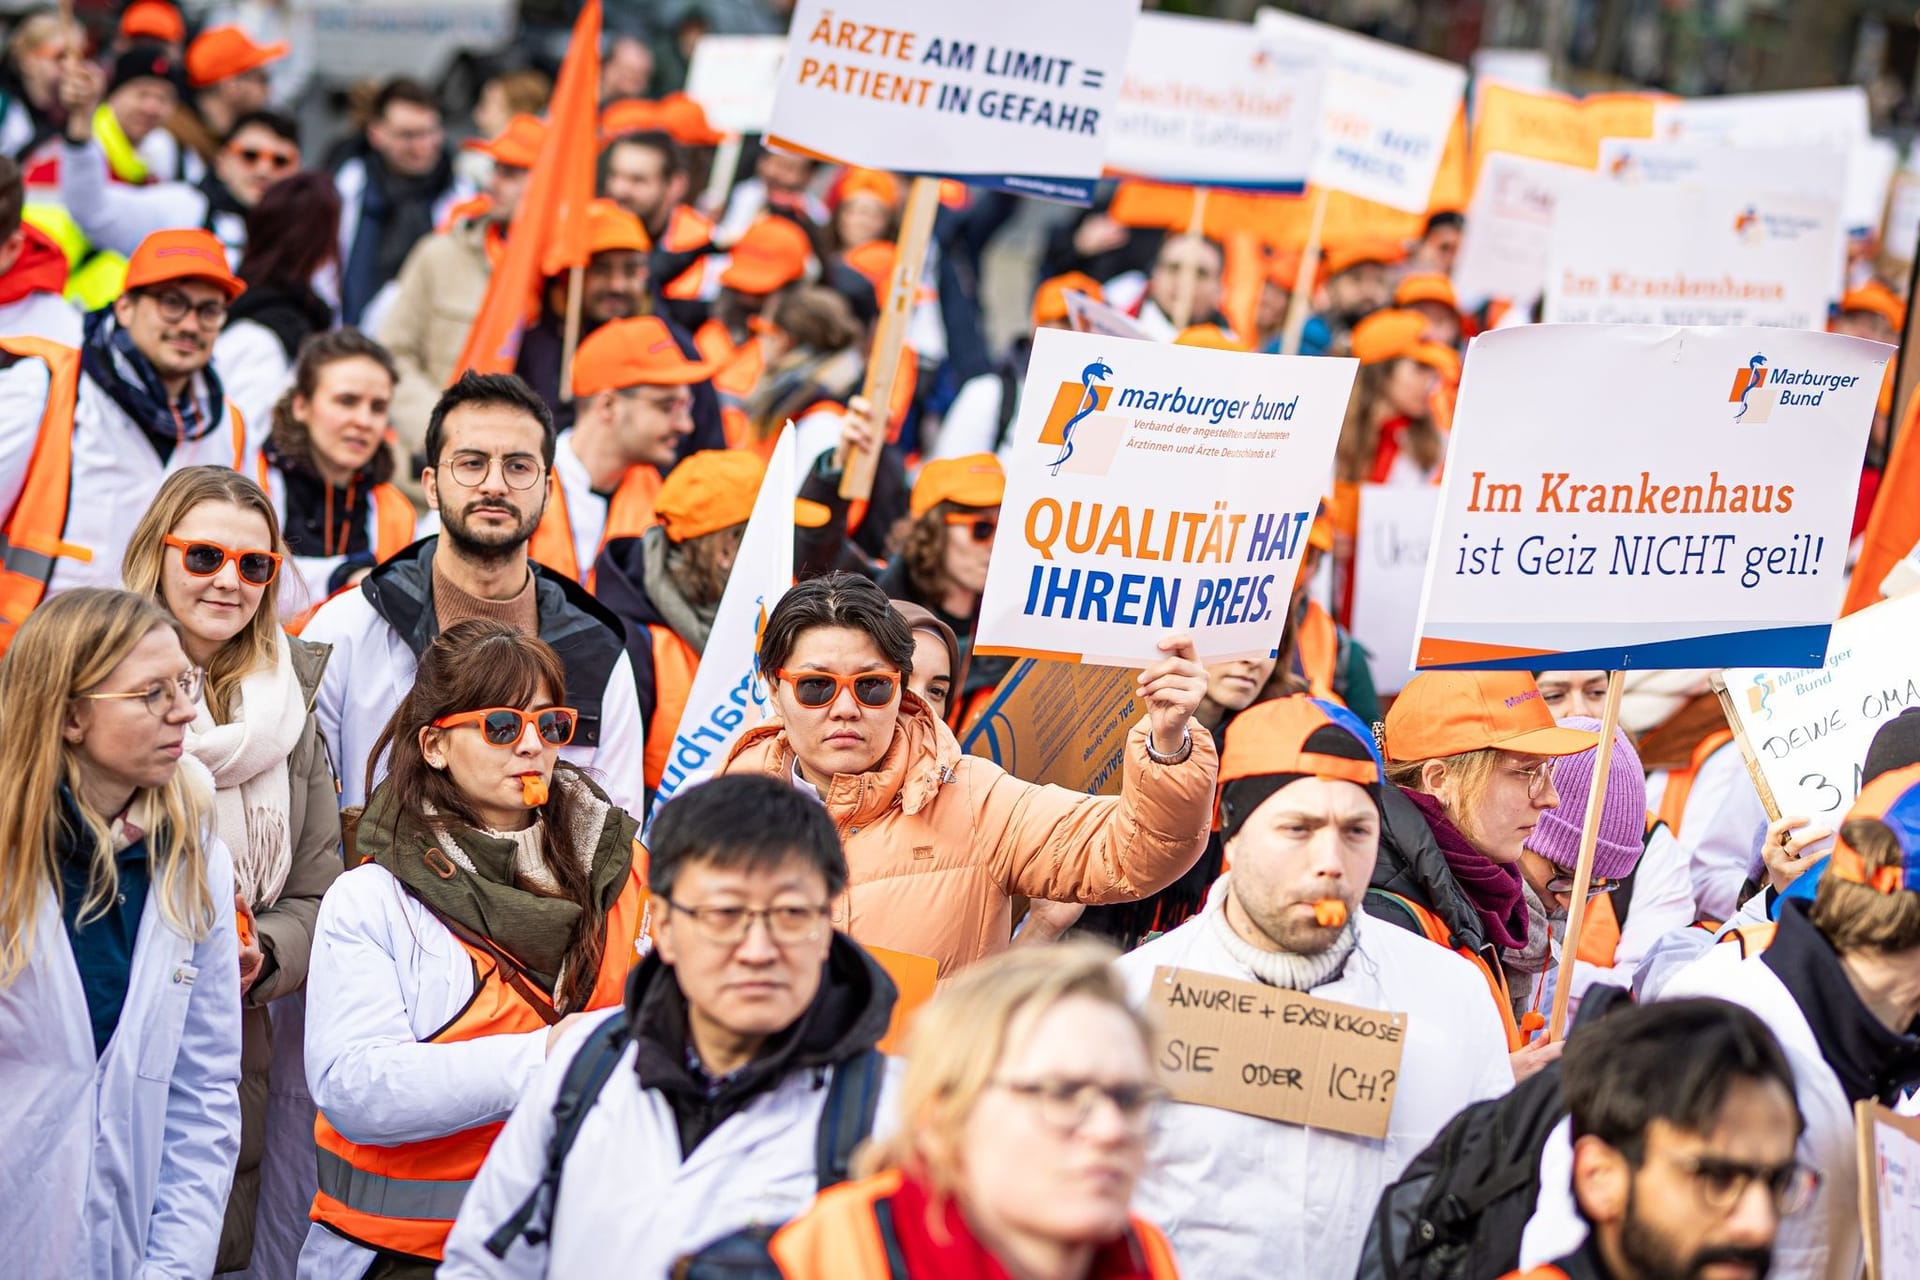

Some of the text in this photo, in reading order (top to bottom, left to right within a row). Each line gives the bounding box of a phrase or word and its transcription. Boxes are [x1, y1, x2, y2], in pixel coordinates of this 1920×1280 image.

[810, 10, 916, 61] ÄRZTE
[922, 38, 977, 70] AM
[986, 48, 1073, 87] LIMIT
[799, 58, 1100, 136] PATIENT IN GEFAHR
[1770, 369, 1859, 391] Marburger
[1780, 390, 1824, 406] Bund
[1118, 387, 1299, 425] marburger bund
[1134, 419, 1173, 433] Verband
[1176, 423, 1191, 434] der
[1193, 426, 1242, 439] angestellten
[1243, 430, 1257, 439] und
[1126, 436, 1174, 453] Ärztinnen
[1176, 445, 1194, 455] und
[1196, 443, 1220, 457] Ärzte
[1221, 447, 1264, 459] Deutschlands
[1467, 471, 1795, 514] Im Krankenhaus
[1024, 497, 1246, 564] QUALITÄT
[1246, 511, 1309, 562] HAT
[1456, 533, 1504, 575] ist
[1517, 533, 1597, 576] Geiz
[1609, 535, 1736, 576] NICHT
[1741, 533, 1824, 588] geil!
[1023, 565, 1275, 628] IHREN PREIS.
[1796, 671, 1832, 696] Bund
[1762, 709, 1847, 759] DEINE
[1798, 773, 1842, 812] 3
[1168, 983, 1256, 1014] ANURIE
[1283, 1003, 1402, 1043] EXSIKKOSE
[1160, 1039, 1396, 1103] SIE ODER ICH?
